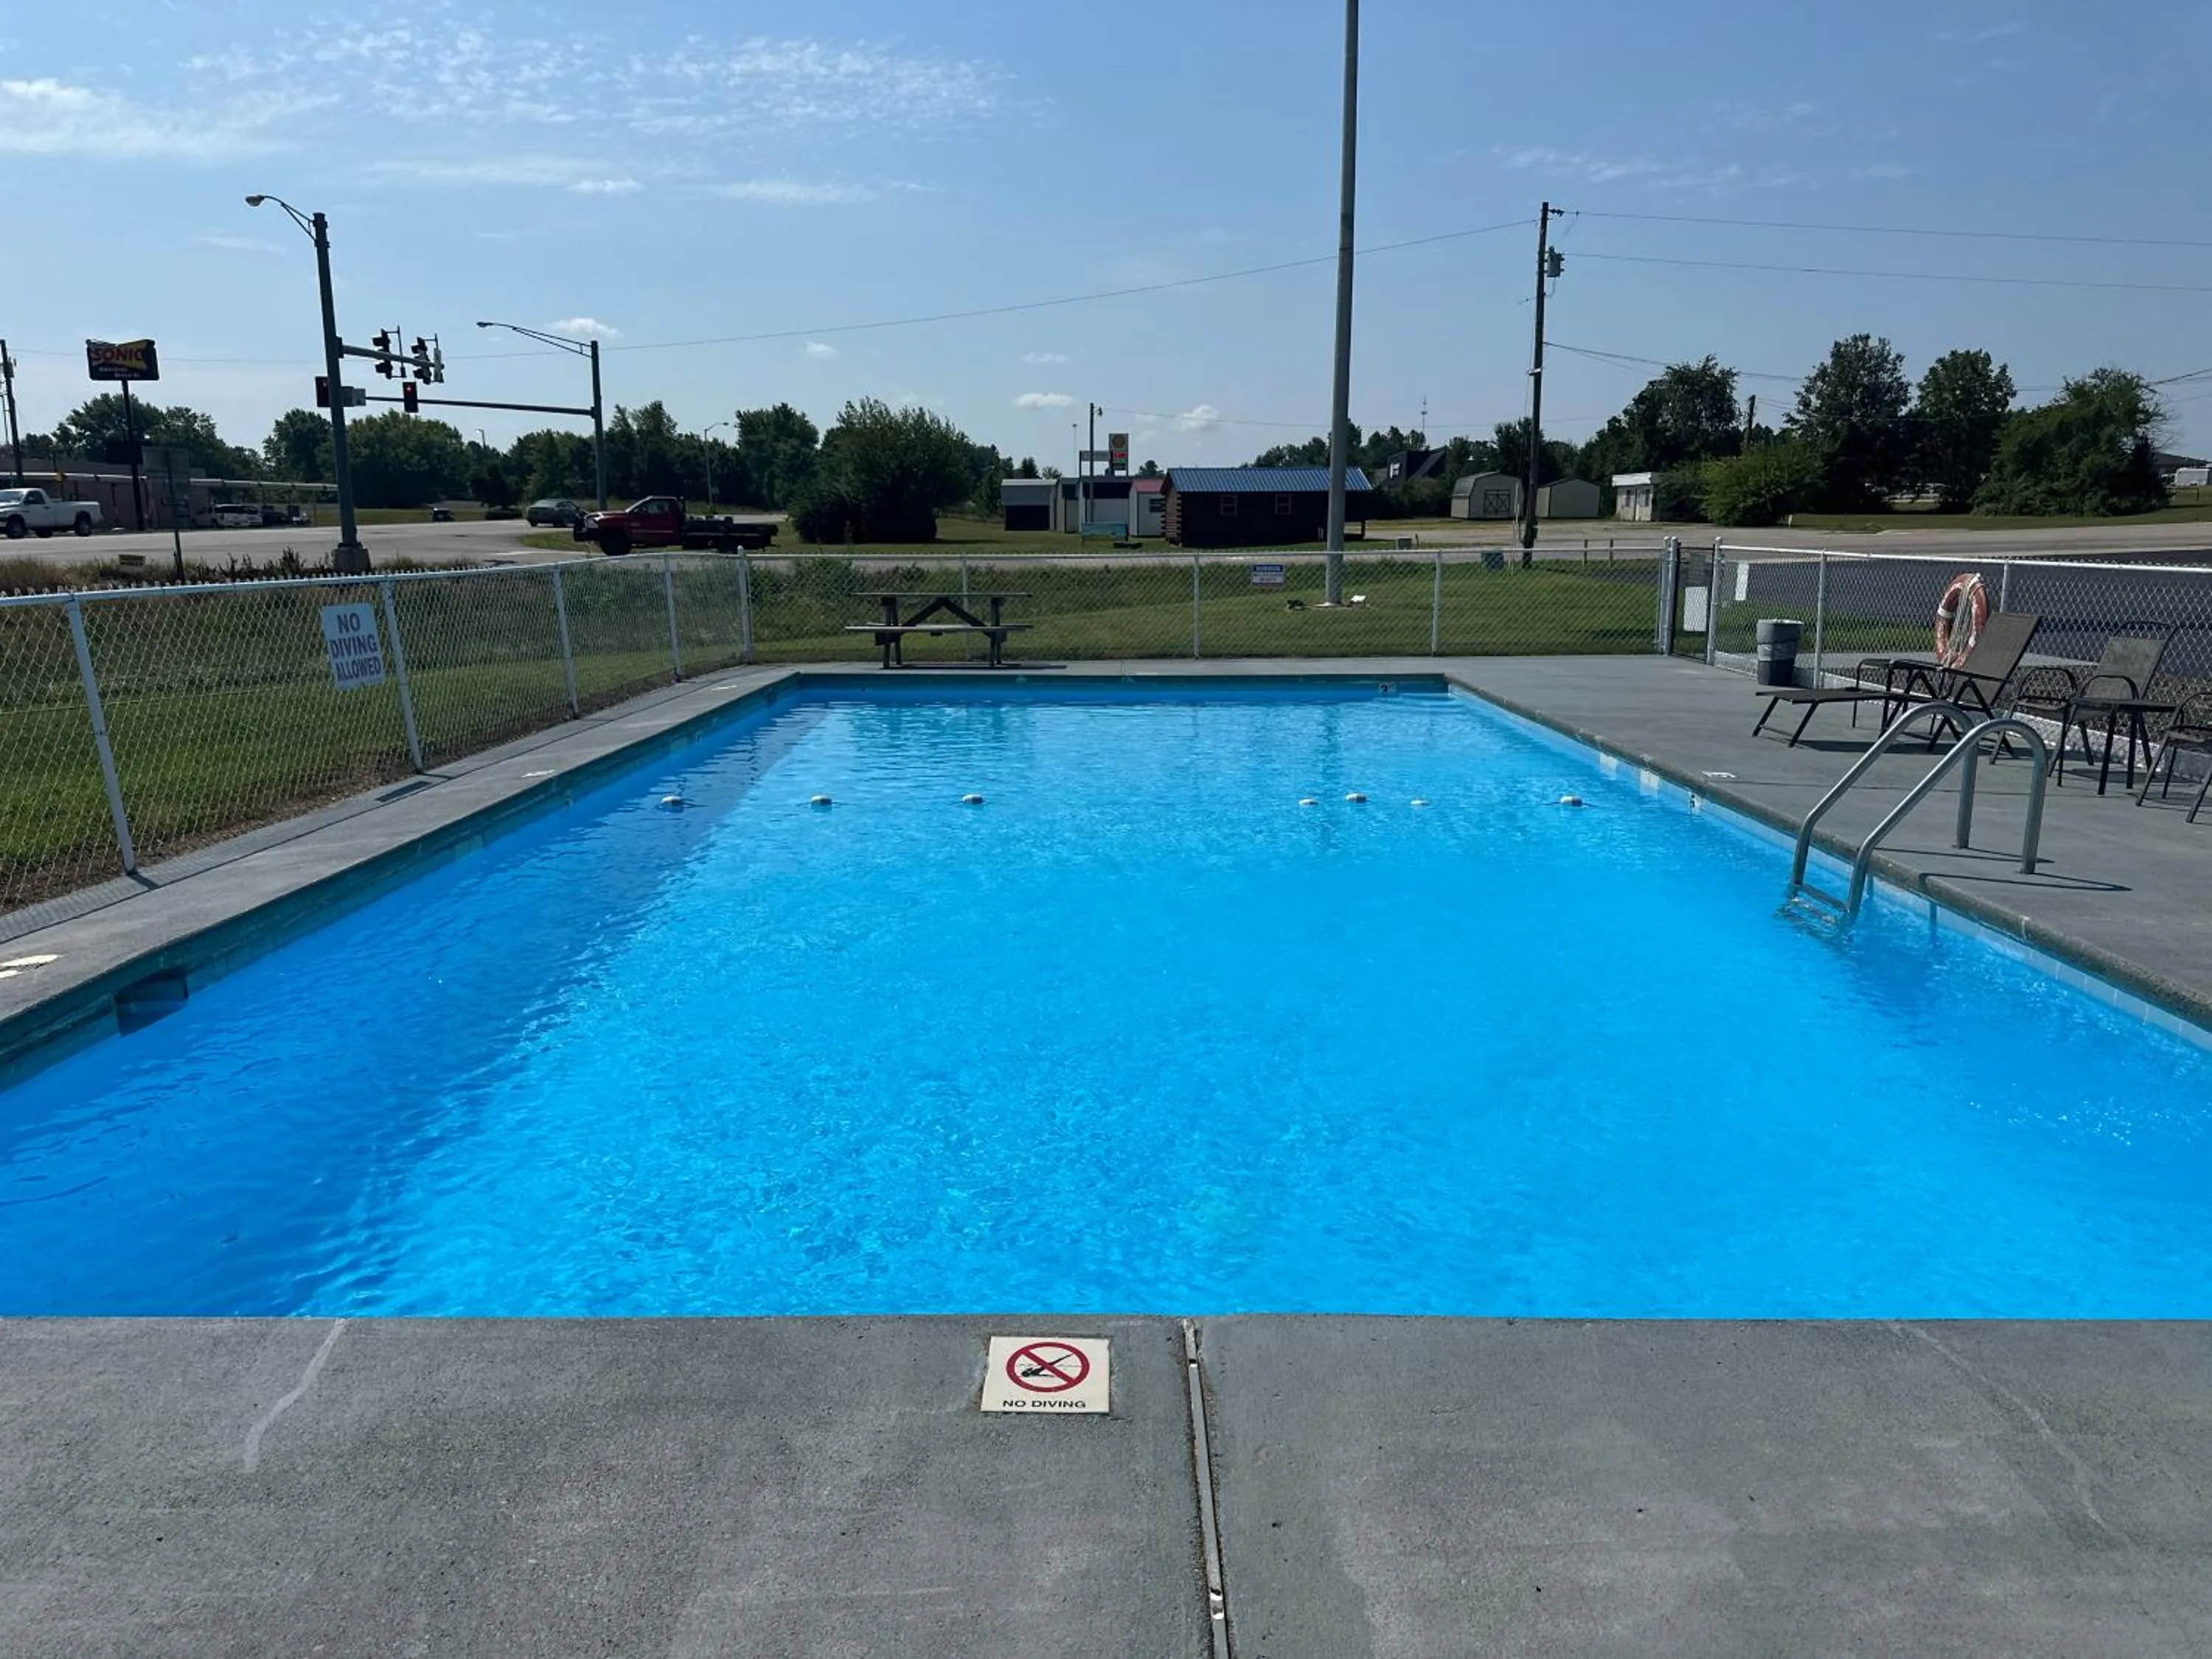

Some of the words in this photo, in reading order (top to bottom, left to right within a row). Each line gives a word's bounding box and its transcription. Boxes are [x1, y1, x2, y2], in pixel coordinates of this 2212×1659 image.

[90, 347, 143, 361] SONIC
[336, 613, 361, 633] NO
[330, 634, 378, 658] DIVING
[336, 655, 381, 681] ALLOWED
[1032, 1400, 1086, 1408] DIVING
